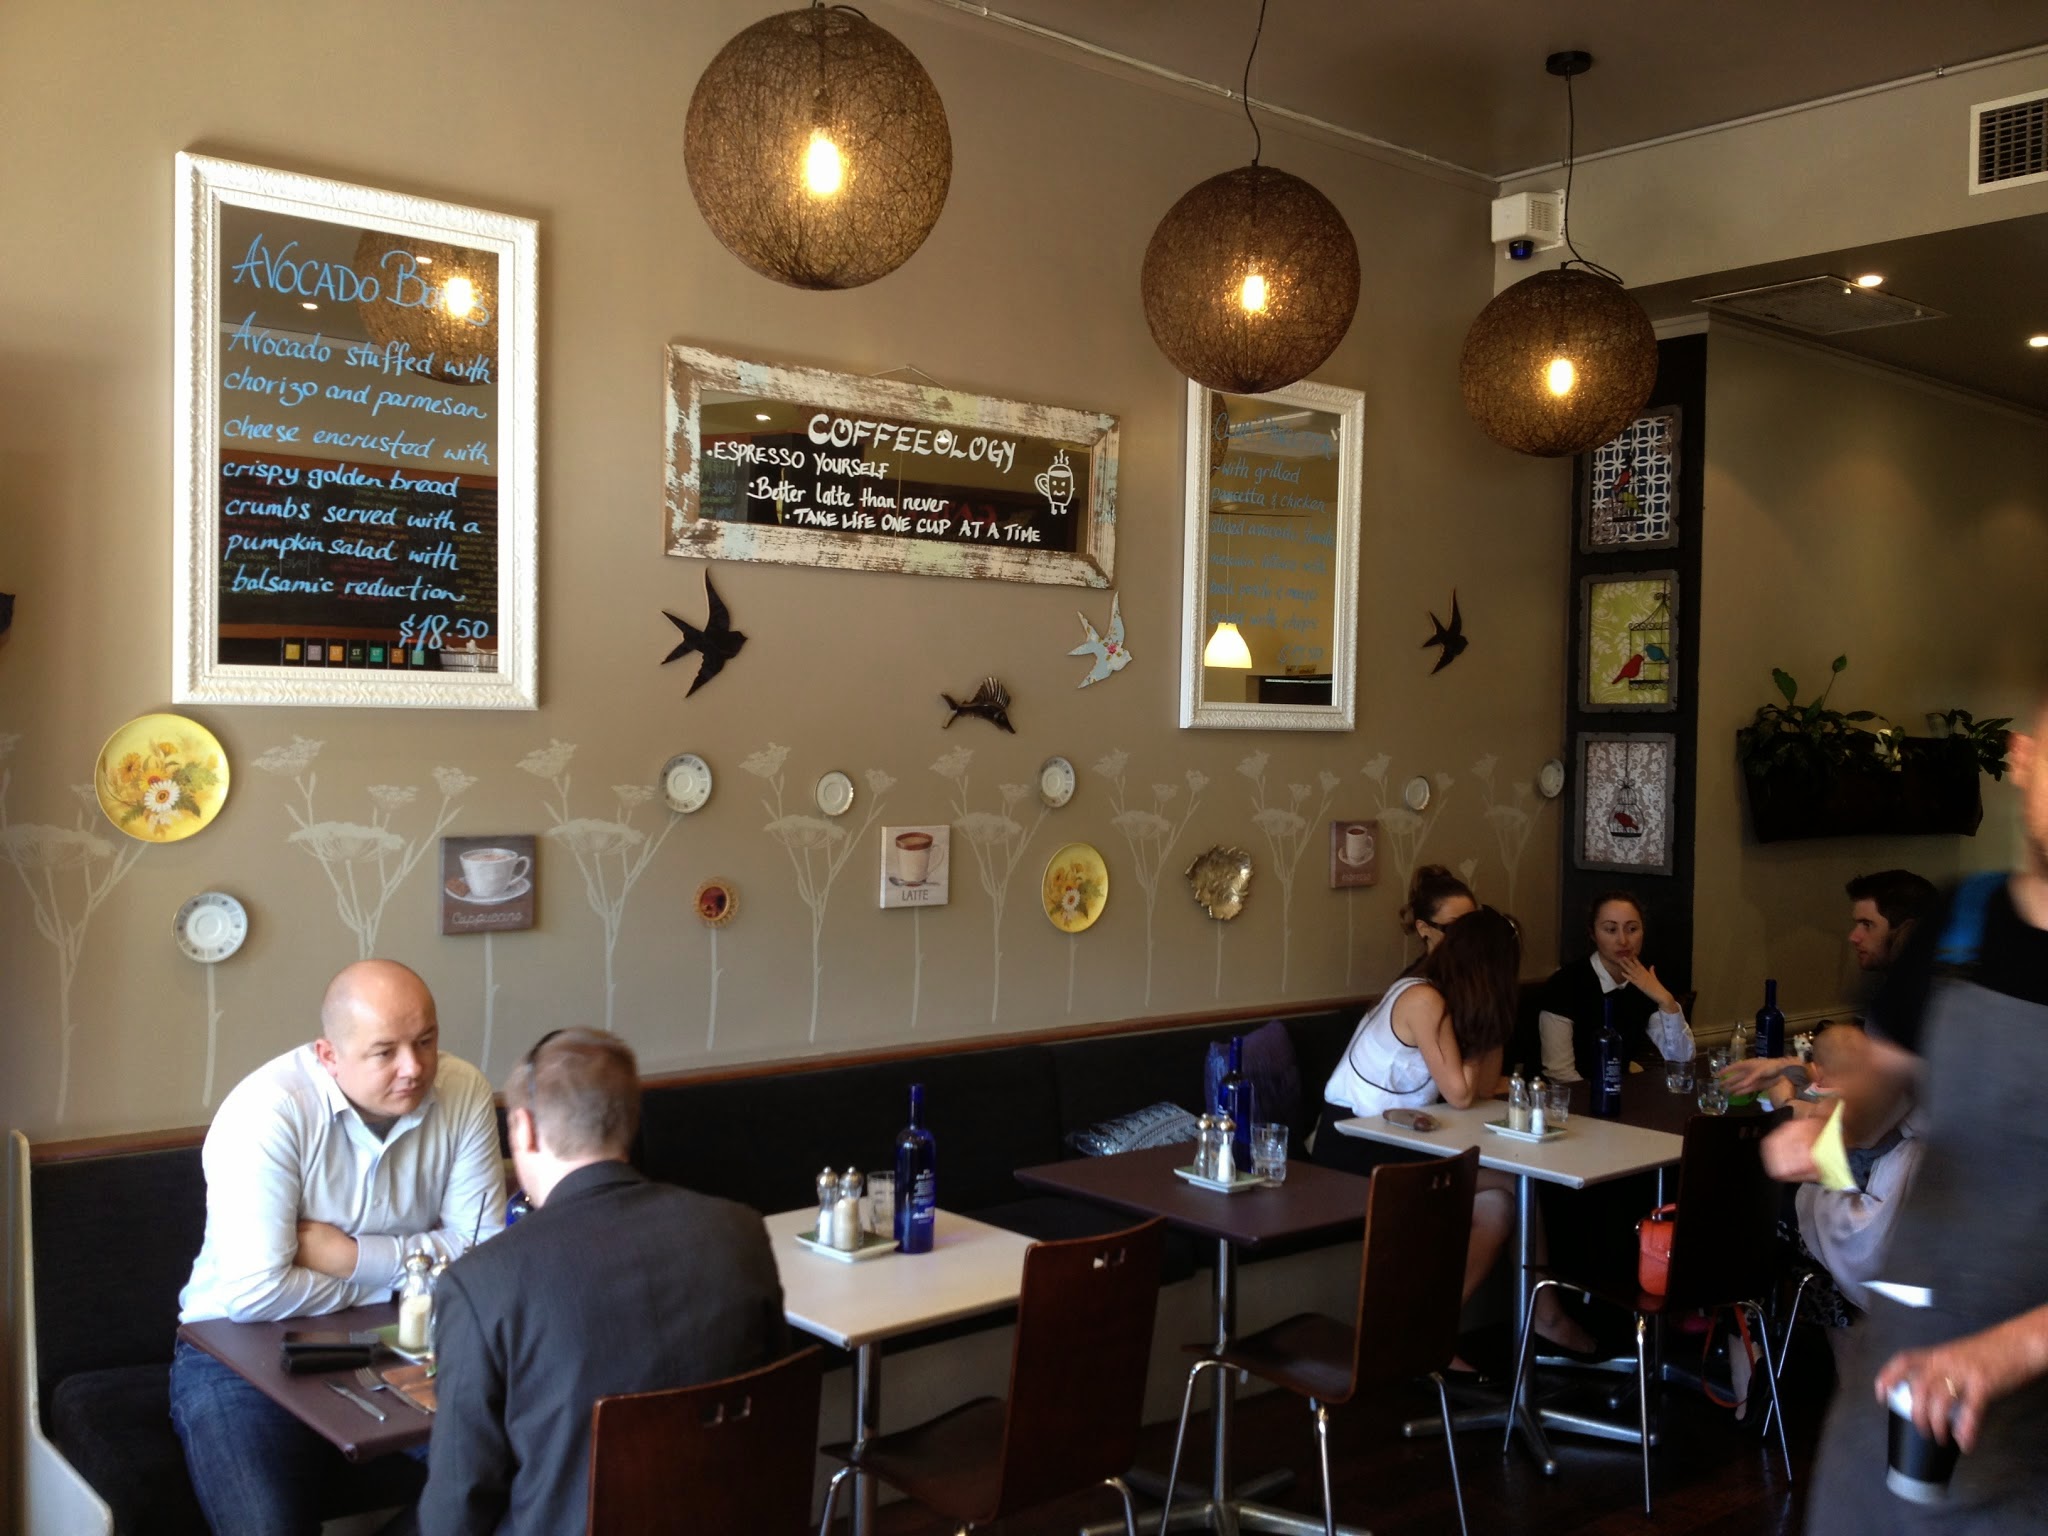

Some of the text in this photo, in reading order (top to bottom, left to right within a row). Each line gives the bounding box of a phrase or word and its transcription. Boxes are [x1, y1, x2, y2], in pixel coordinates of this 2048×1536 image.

[232, 233, 380, 302] AVOCADO
[228, 311, 492, 384] Avocado stuffed with
[326, 385, 371, 405] and
[224, 415, 490, 465] cheese encrusted with
[807, 413, 1016, 473] COFFEEOLOGY
[223, 460, 299, 485] crispy
[308, 464, 383, 489] golden
[389, 470, 460, 498] bread
[713, 441, 806, 469] ESPRESSO
[812, 452, 890, 480] YOURSELF
[1255, 462, 1300, 484] grilled
[747, 477, 807, 504] Better
[816, 482, 853, 507] latte
[860, 487, 897, 509] than
[904, 496, 949, 513] never
[225, 496, 482, 534] crumbs served with a
[794, 508, 838, 527] TAKE
[881, 513, 911, 533] ONE
[959, 521, 982, 538] AT
[986, 521, 1000, 540] A
[224, 533, 324, 561] pumpkin
[328, 539, 397, 561] salad
[408, 541, 460, 570] with
[231, 563, 335, 593] balsamic
[345, 576, 466, 602] reduction
[398, 613, 490, 651] $18.50
[902, 890, 928, 901] LATTE
